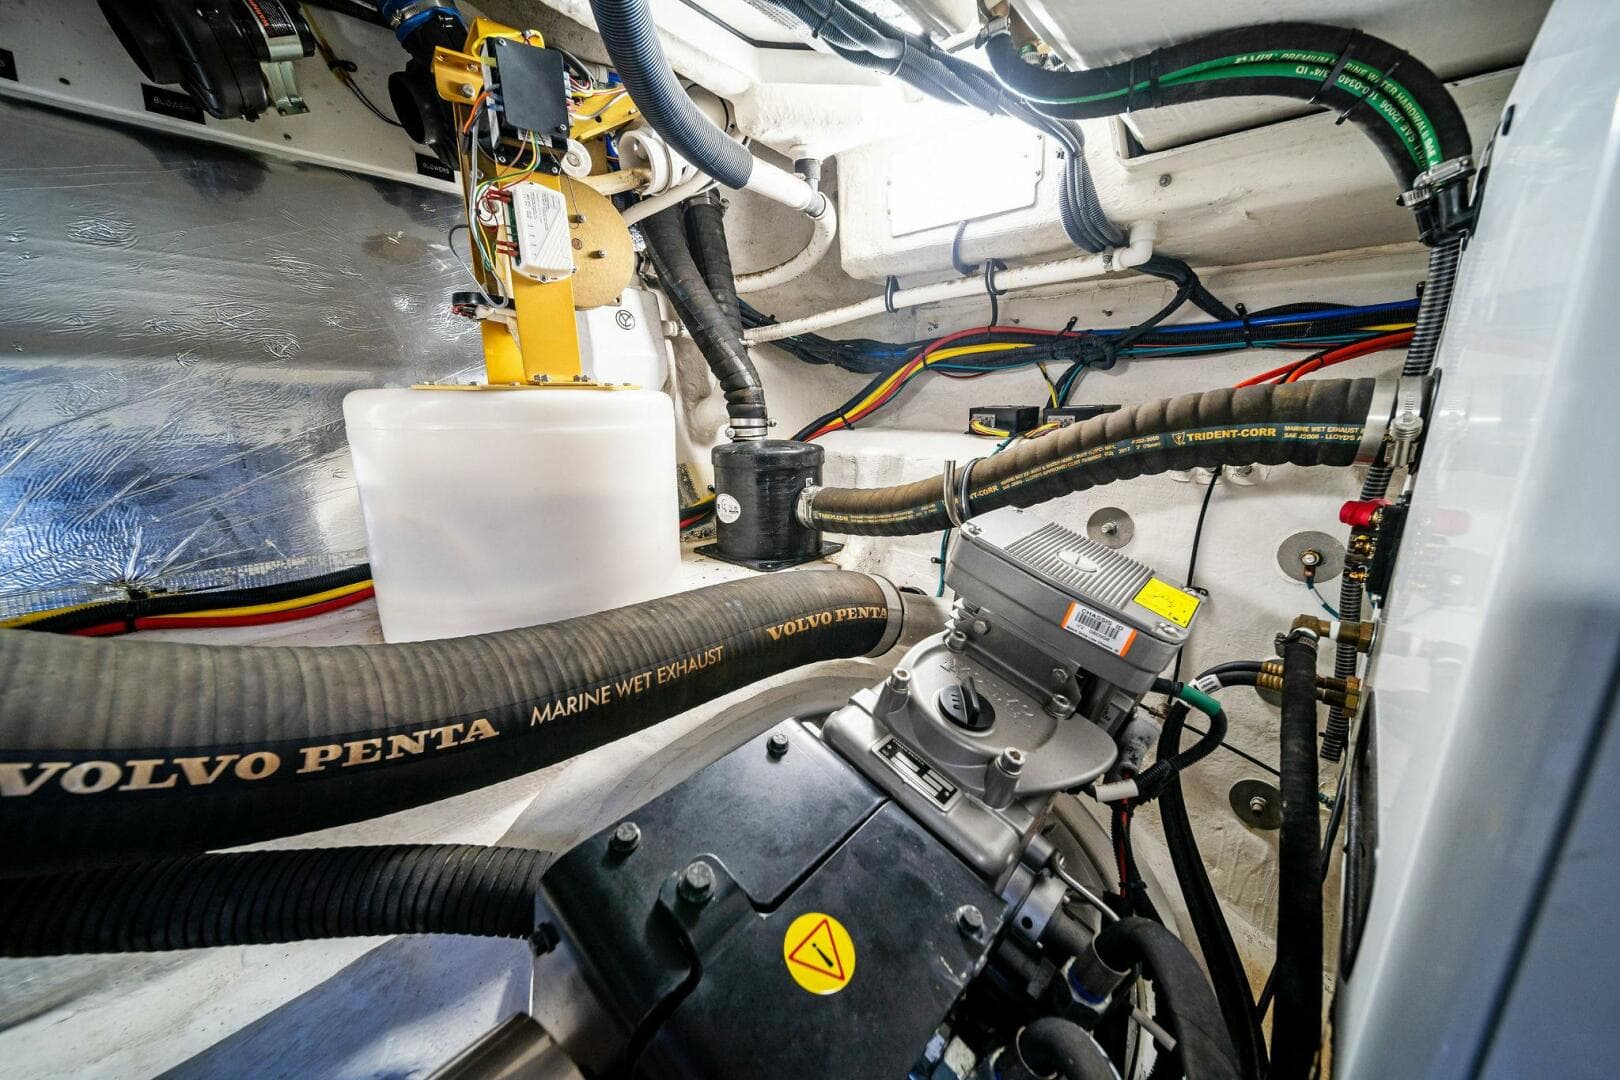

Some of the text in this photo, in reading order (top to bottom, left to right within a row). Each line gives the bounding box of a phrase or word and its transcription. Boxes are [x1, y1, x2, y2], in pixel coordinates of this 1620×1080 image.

[1280, 52, 1329, 63] PREMIUM
[1329, 58, 1368, 76] MRINE
[1396, 92, 1430, 138] HARDWALL
[1186, 427, 1277, 442] TRIDENT-CORR
[1283, 425, 1310, 433] MARINE
[1327, 426, 1360, 434] EXHAUST
[765, 606, 889, 642] VOLVO PENTA
[1081, 608, 1124, 632] CHASSIS ID
[530, 646, 725, 727] MARINE WET EXHAUST
[0, 718, 500, 797] VOLVO PENTA
